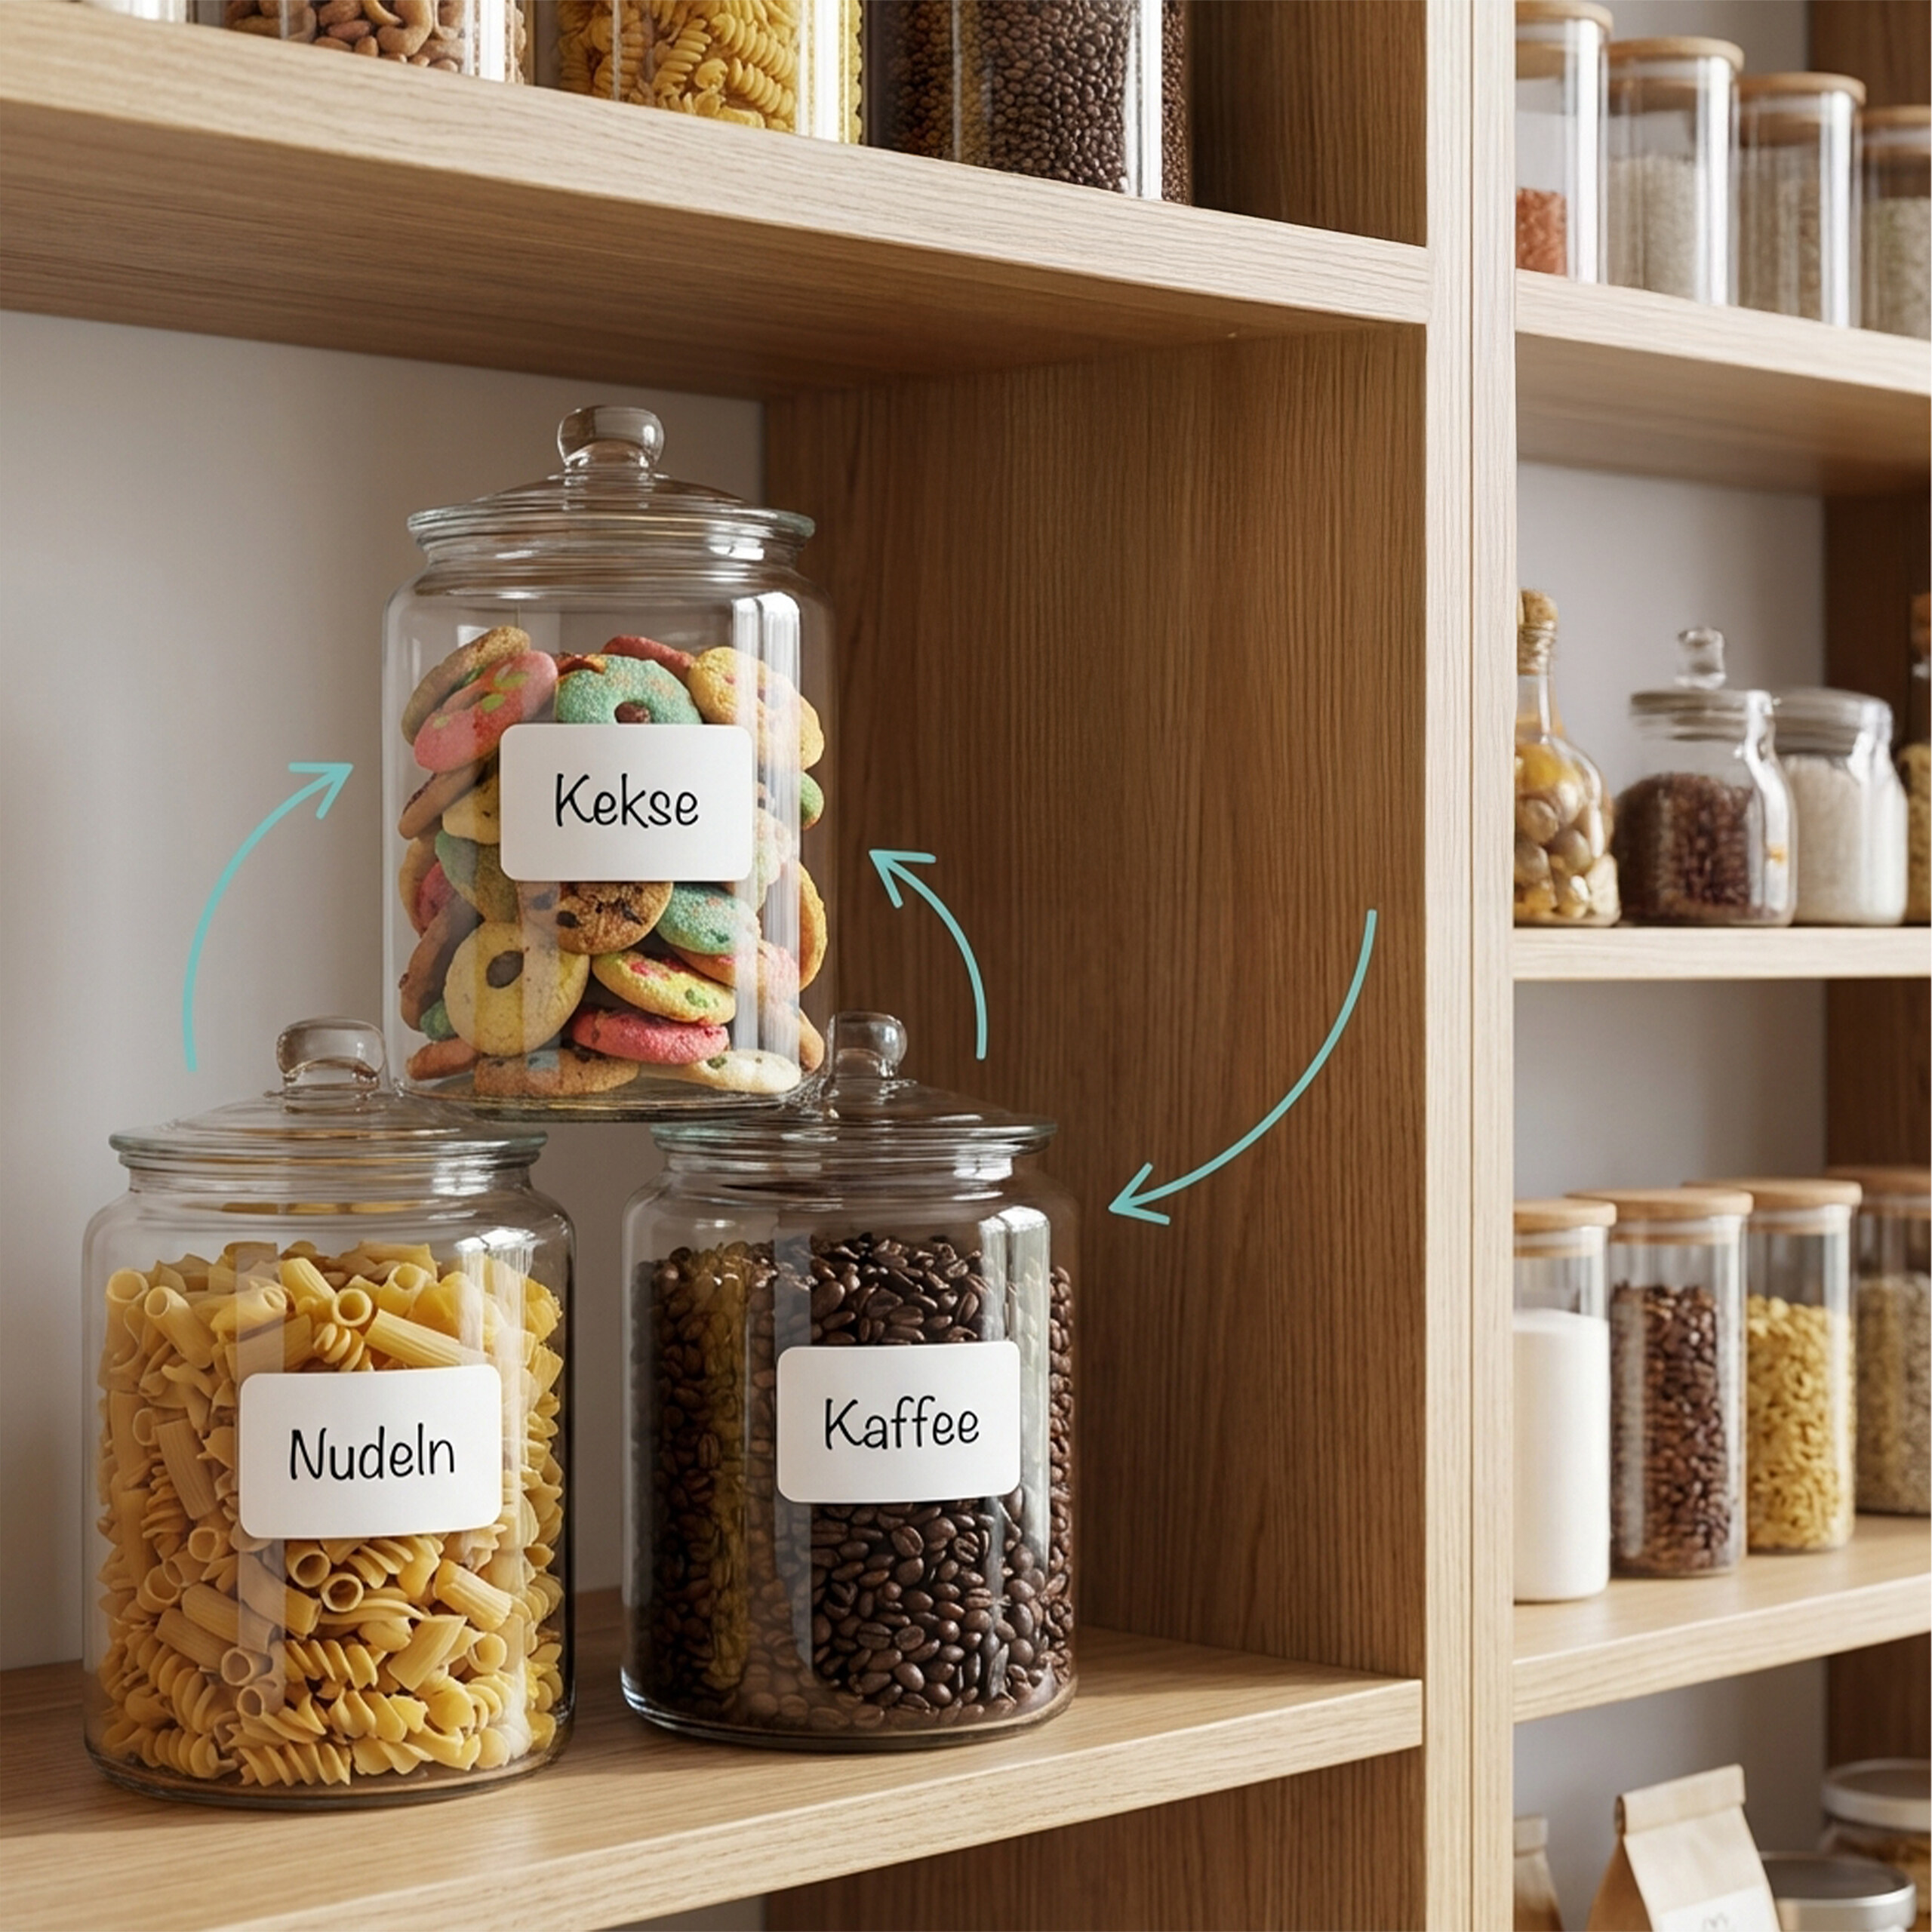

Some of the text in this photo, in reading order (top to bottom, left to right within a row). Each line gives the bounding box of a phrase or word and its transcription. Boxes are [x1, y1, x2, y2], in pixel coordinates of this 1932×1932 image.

[555, 773, 699, 829] Kekse
[825, 1395, 980, 1451] Kaffee
[290, 1423, 455, 1481] Nudeln
